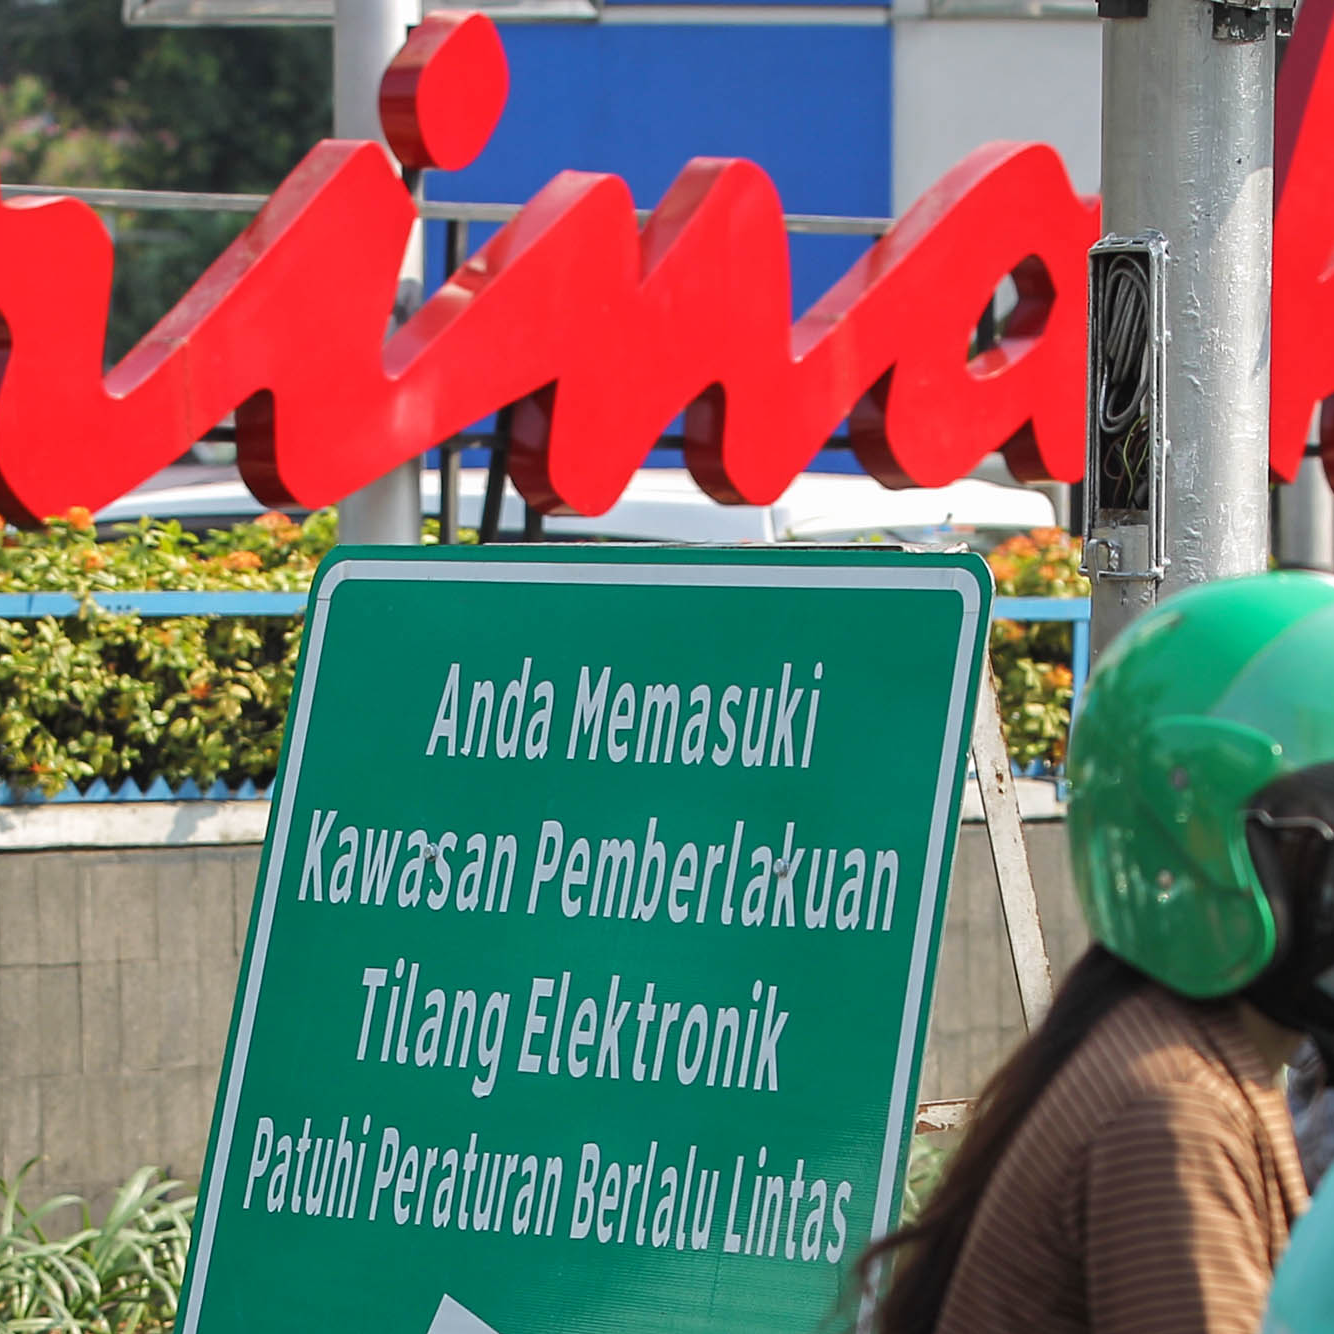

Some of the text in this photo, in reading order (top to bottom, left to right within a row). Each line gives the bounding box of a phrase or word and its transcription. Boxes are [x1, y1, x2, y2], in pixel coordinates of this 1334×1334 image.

[425, 657, 823, 769] Anda Memasuki
[297, 808, 900, 932] Kawasan Pemberlakuan
[355, 957, 790, 1099] Tilang Elektronik
[242, 1114, 853, 1265] Patuhi Peraturan Berlalu Lintas
